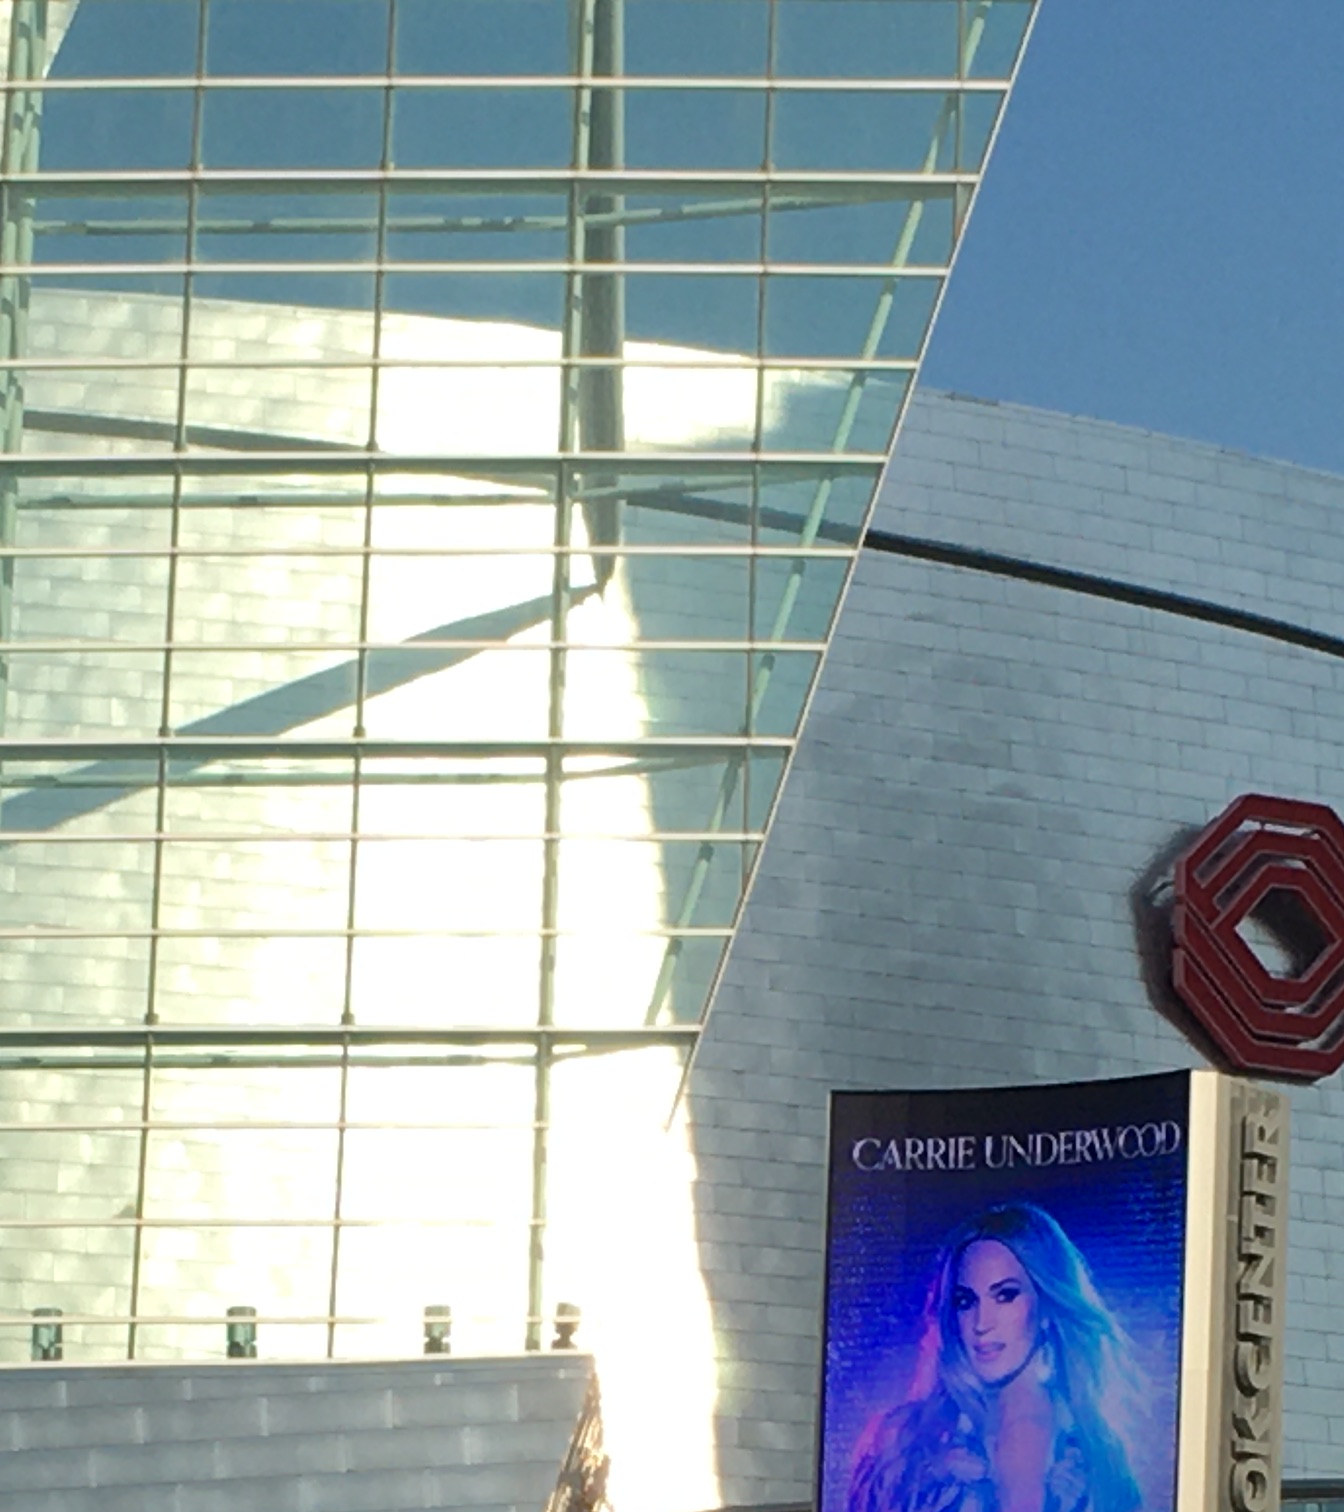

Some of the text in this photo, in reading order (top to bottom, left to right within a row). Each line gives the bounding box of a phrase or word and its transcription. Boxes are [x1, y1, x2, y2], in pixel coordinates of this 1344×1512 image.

[852, 1120, 1181, 1171] CARRIE UNDERWOOD
[1233, 1098, 1284, 1398] CENTER
